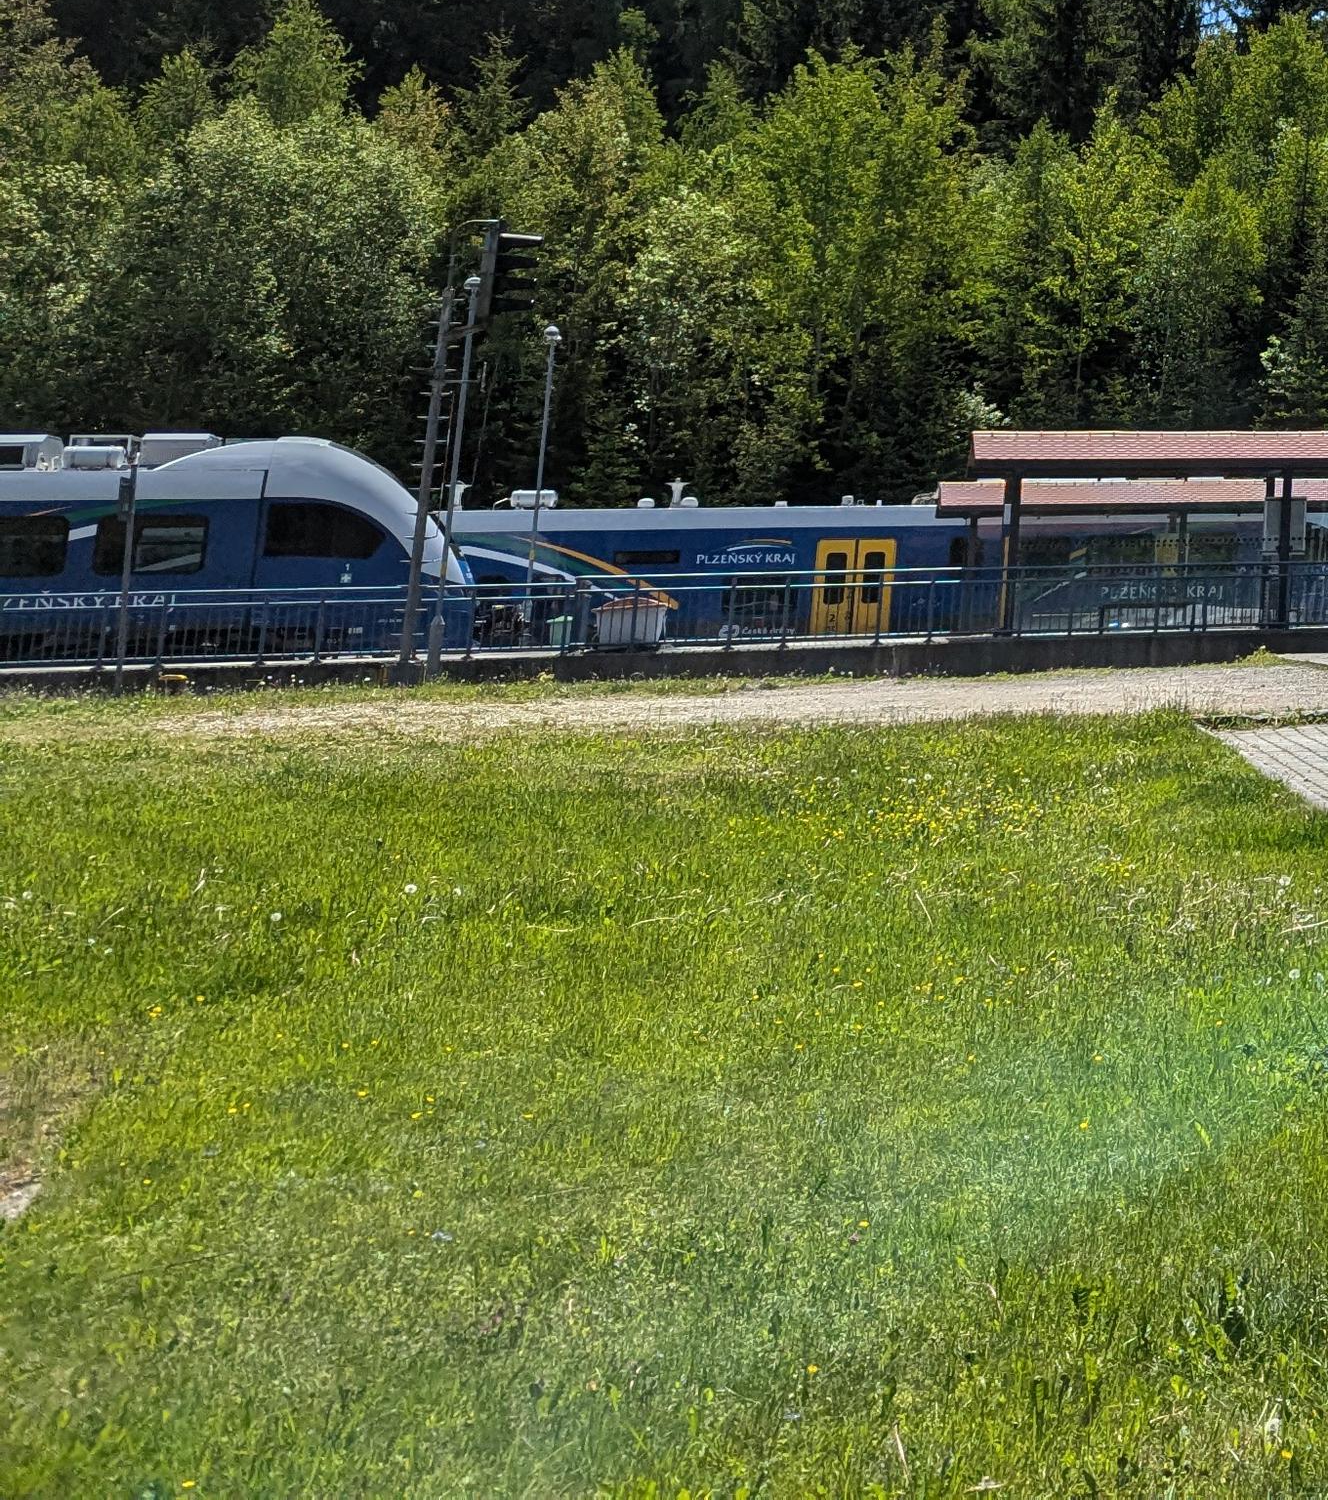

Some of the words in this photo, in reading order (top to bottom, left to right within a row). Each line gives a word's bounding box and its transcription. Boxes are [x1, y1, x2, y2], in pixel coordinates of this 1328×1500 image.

[696, 552, 763, 565] PLZEŇSKÝ
[765, 552, 796, 566] KRAJ
[828, 613, 836, 622] 2
